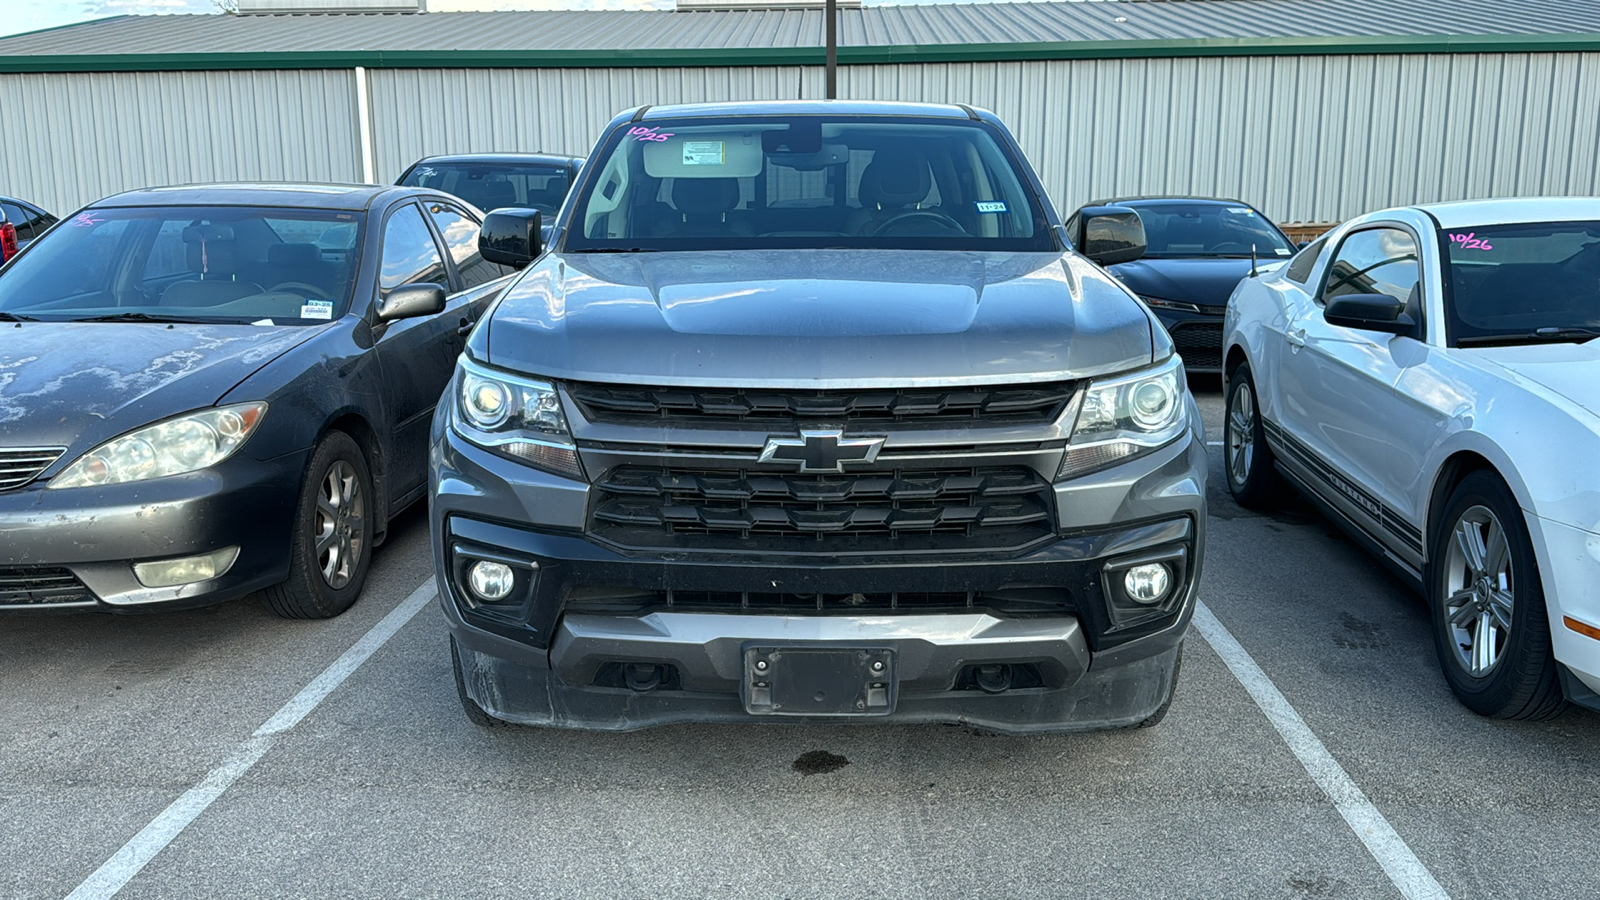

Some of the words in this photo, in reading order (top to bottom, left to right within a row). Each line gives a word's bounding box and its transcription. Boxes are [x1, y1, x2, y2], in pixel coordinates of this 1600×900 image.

[626, 126, 675, 142] 10/25
[1448, 232, 1493, 250] 10/26
[1331, 475, 1376, 513] MUSTANG
